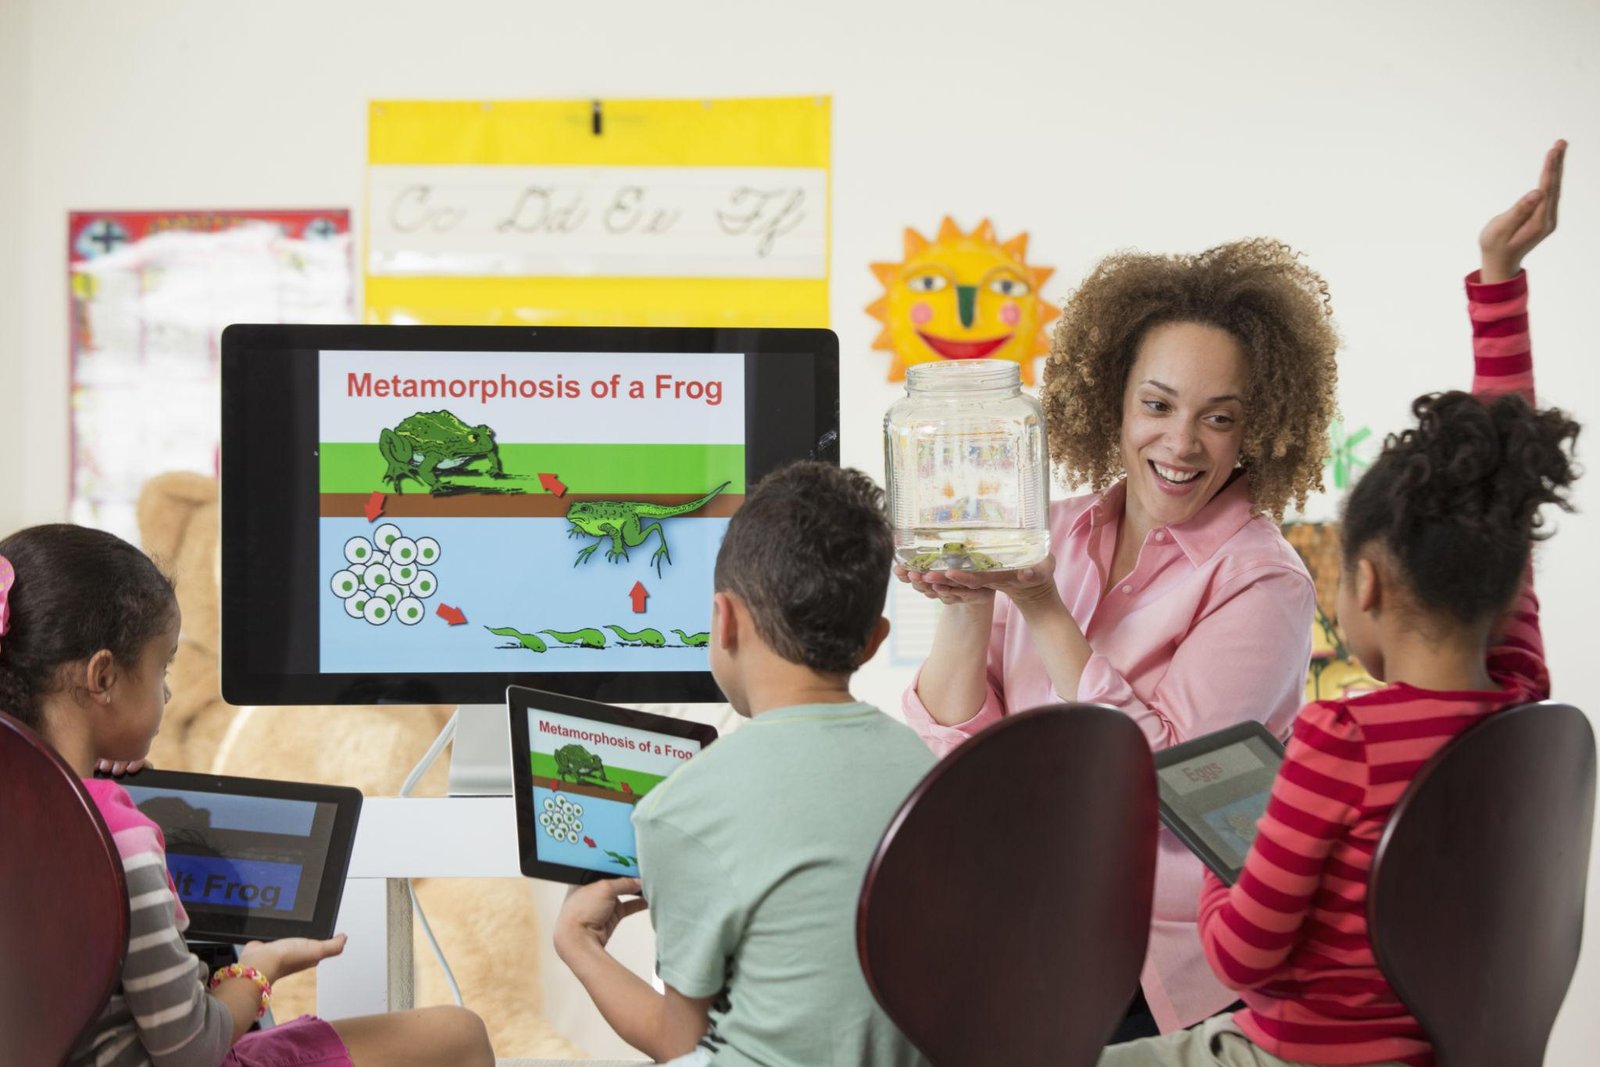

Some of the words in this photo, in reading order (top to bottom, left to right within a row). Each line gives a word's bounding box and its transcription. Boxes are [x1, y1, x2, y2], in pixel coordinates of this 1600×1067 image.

[389, 184, 467, 234] Cc
[495, 184, 589, 236] Dd
[347, 372, 580, 404] Metamorphosis
[591, 373, 621, 399] of
[628, 379, 645, 399] a
[655, 374, 723, 406] Frog
[538, 719, 635, 750] Metamorphosis
[639, 741, 652, 753] of
[654, 744, 662, 755] a
[1182, 762, 1223, 783] Eggs
[203, 873, 281, 907] Frog
